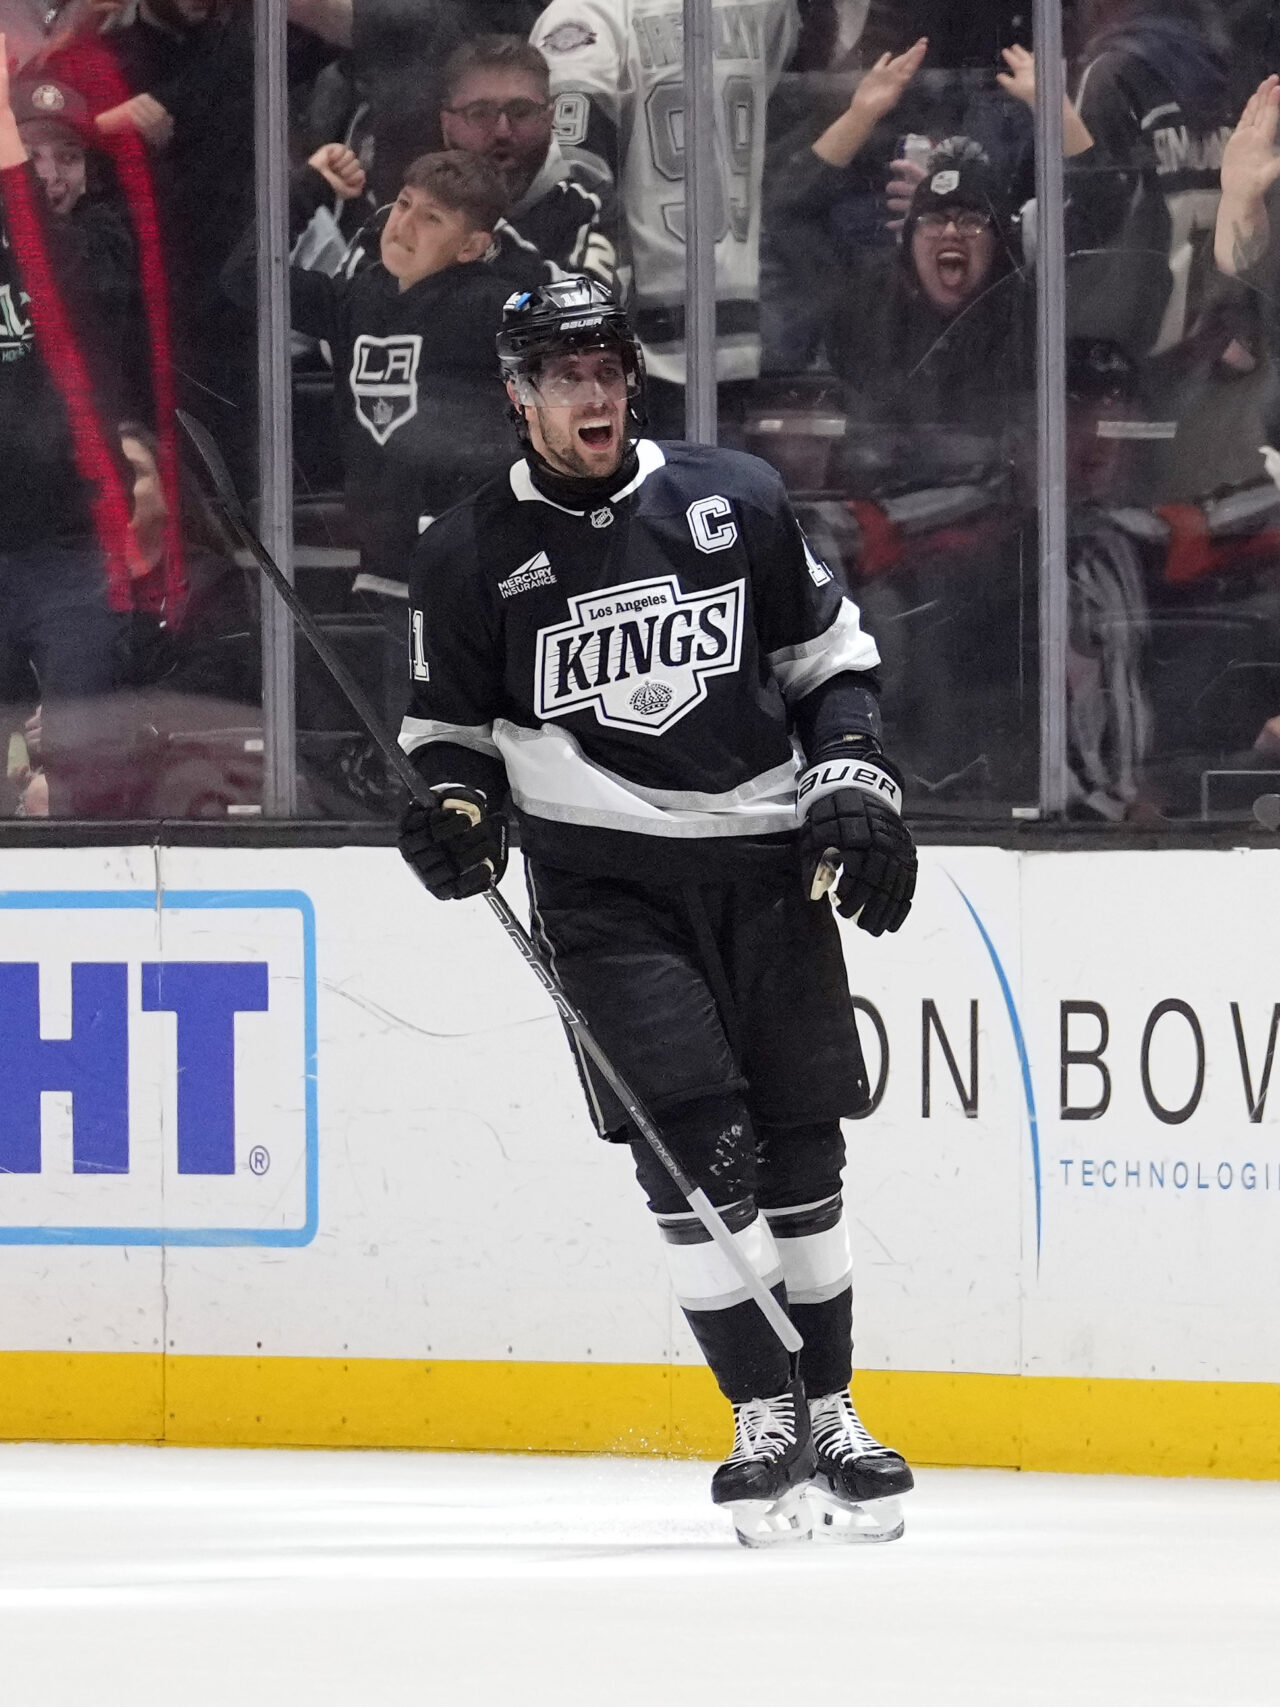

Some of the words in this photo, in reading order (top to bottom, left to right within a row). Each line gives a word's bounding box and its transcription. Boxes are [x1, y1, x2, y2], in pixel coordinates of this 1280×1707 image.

[357, 347, 413, 381] LA
[685, 494, 738, 554] C
[498, 566, 552, 592] MERCURY
[500, 574, 558, 599] INSURANCE
[589, 605, 613, 621] Los
[615, 594, 668, 614] Angeles
[554, 601, 728, 699] KINGS
